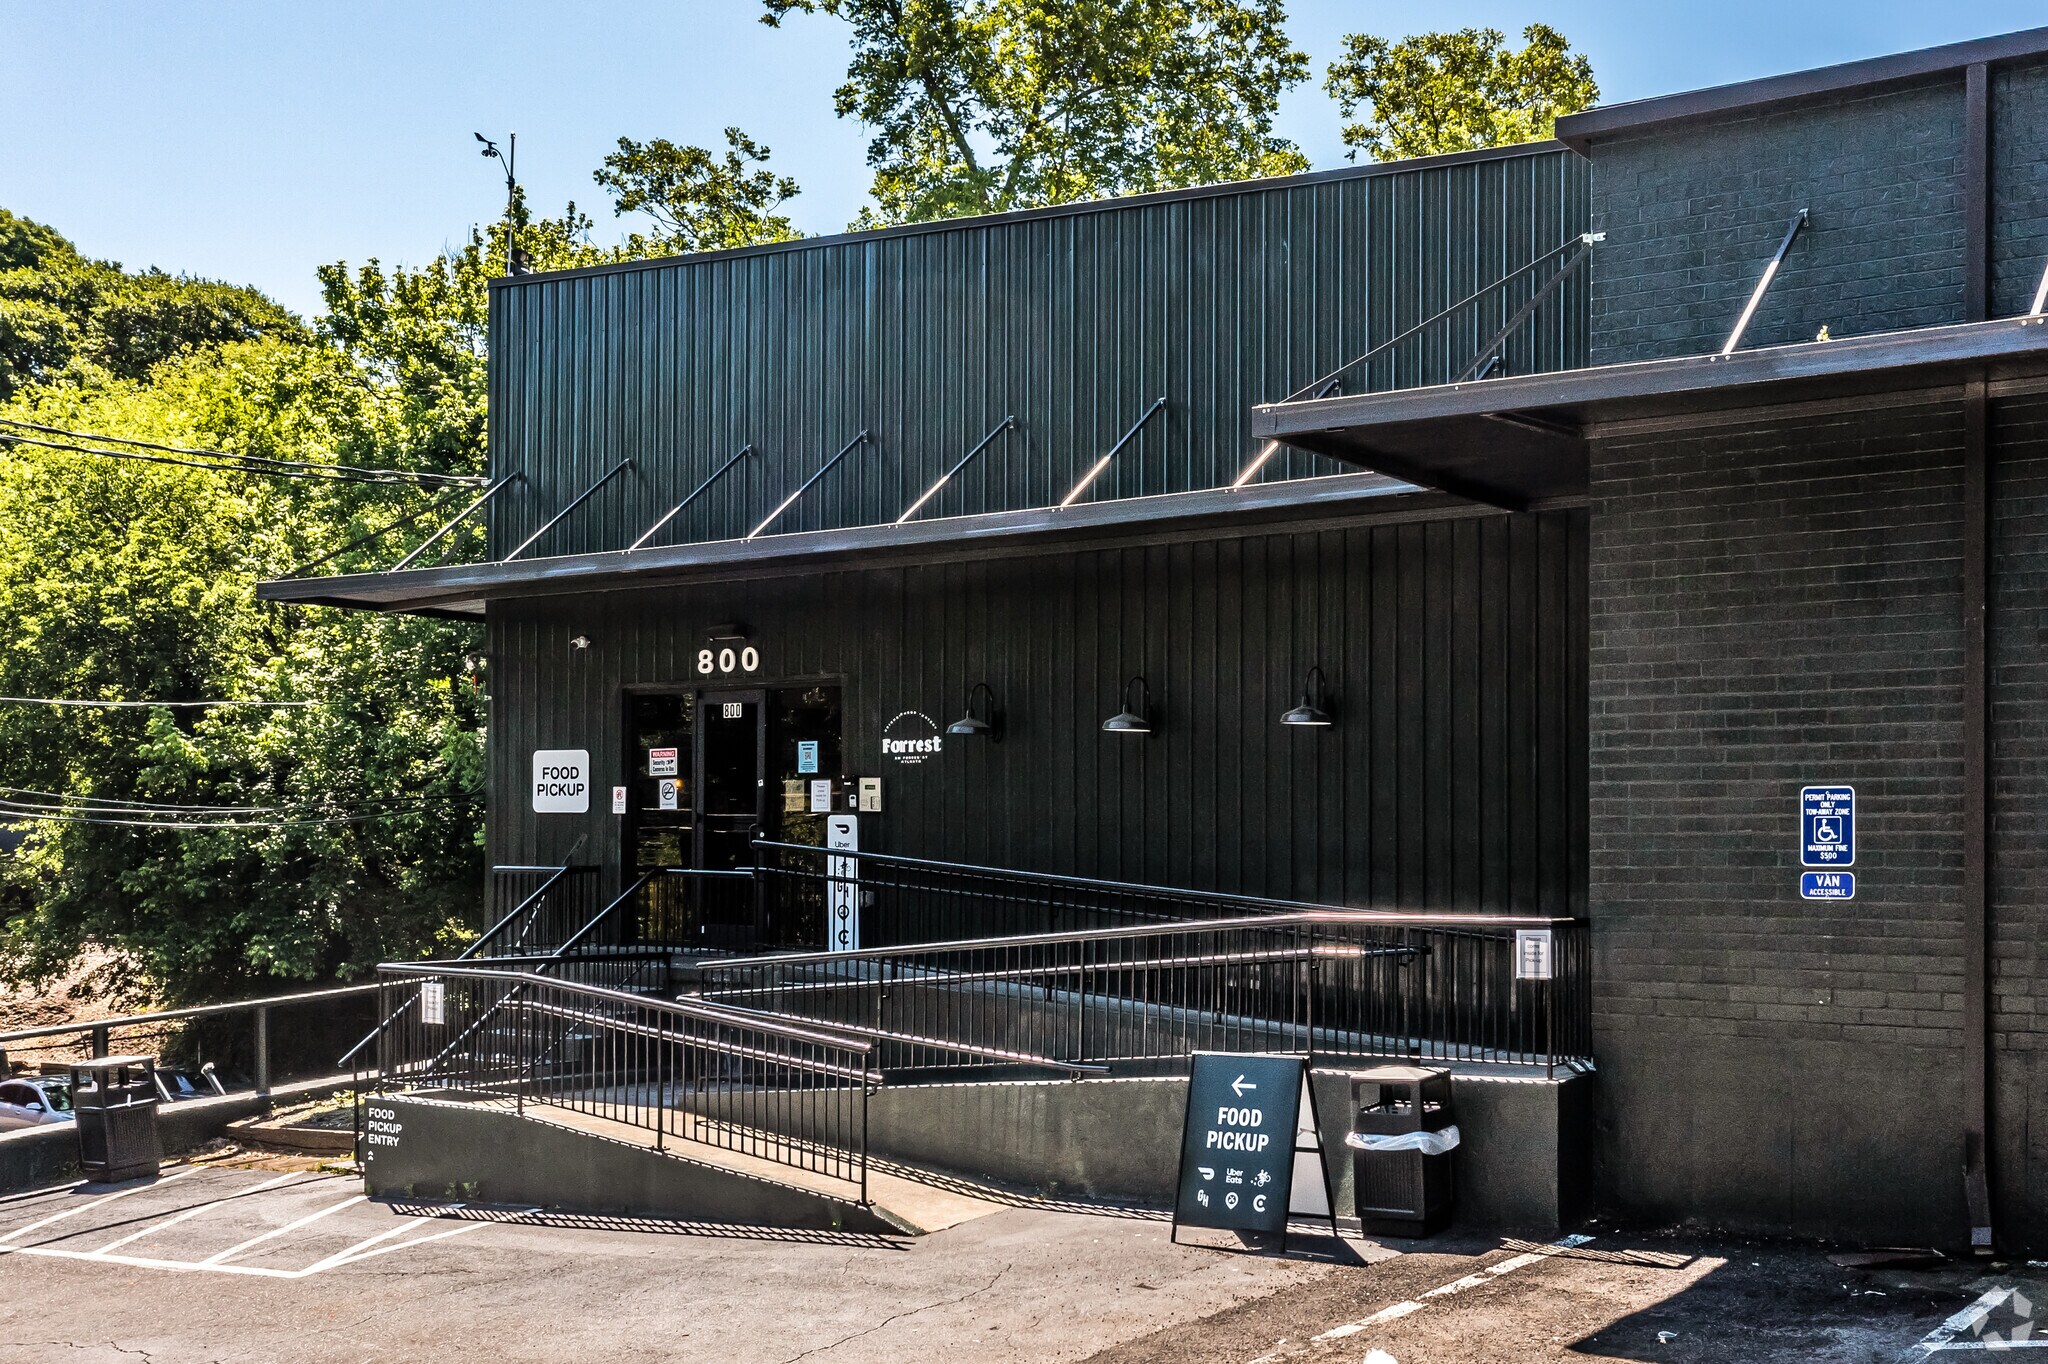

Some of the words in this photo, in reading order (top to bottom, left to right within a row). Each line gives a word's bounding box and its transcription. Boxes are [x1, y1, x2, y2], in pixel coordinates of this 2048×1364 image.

[697, 646, 760, 674] 800
[724, 703, 741, 717] 800
[882, 735, 942, 754] Forrest
[542, 766, 580, 780] FOOD
[537, 783, 585, 797] PICKUP
[1804, 793, 1825, 801] PERMIT
[1826, 793, 1851, 801] PARKING
[1805, 808, 1832, 816] TOW-AWAY
[1807, 844, 1834, 852] MAXIMUM
[1820, 852, 1838, 860] $500
[1816, 875, 1840, 887] VAN
[1809, 888, 1846, 896] ACCESSIBLE
[368, 1107, 395, 1120] FOOD
[1217, 1106, 1263, 1127] FOOD
[368, 1120, 403, 1134] PICKUP
[368, 1133, 400, 1147] ENTRY
[1206, 1130, 1270, 1152] PICKUP
[1226, 1168, 1244, 1176] Uber
[1225, 1175, 1243, 1184] Eats
